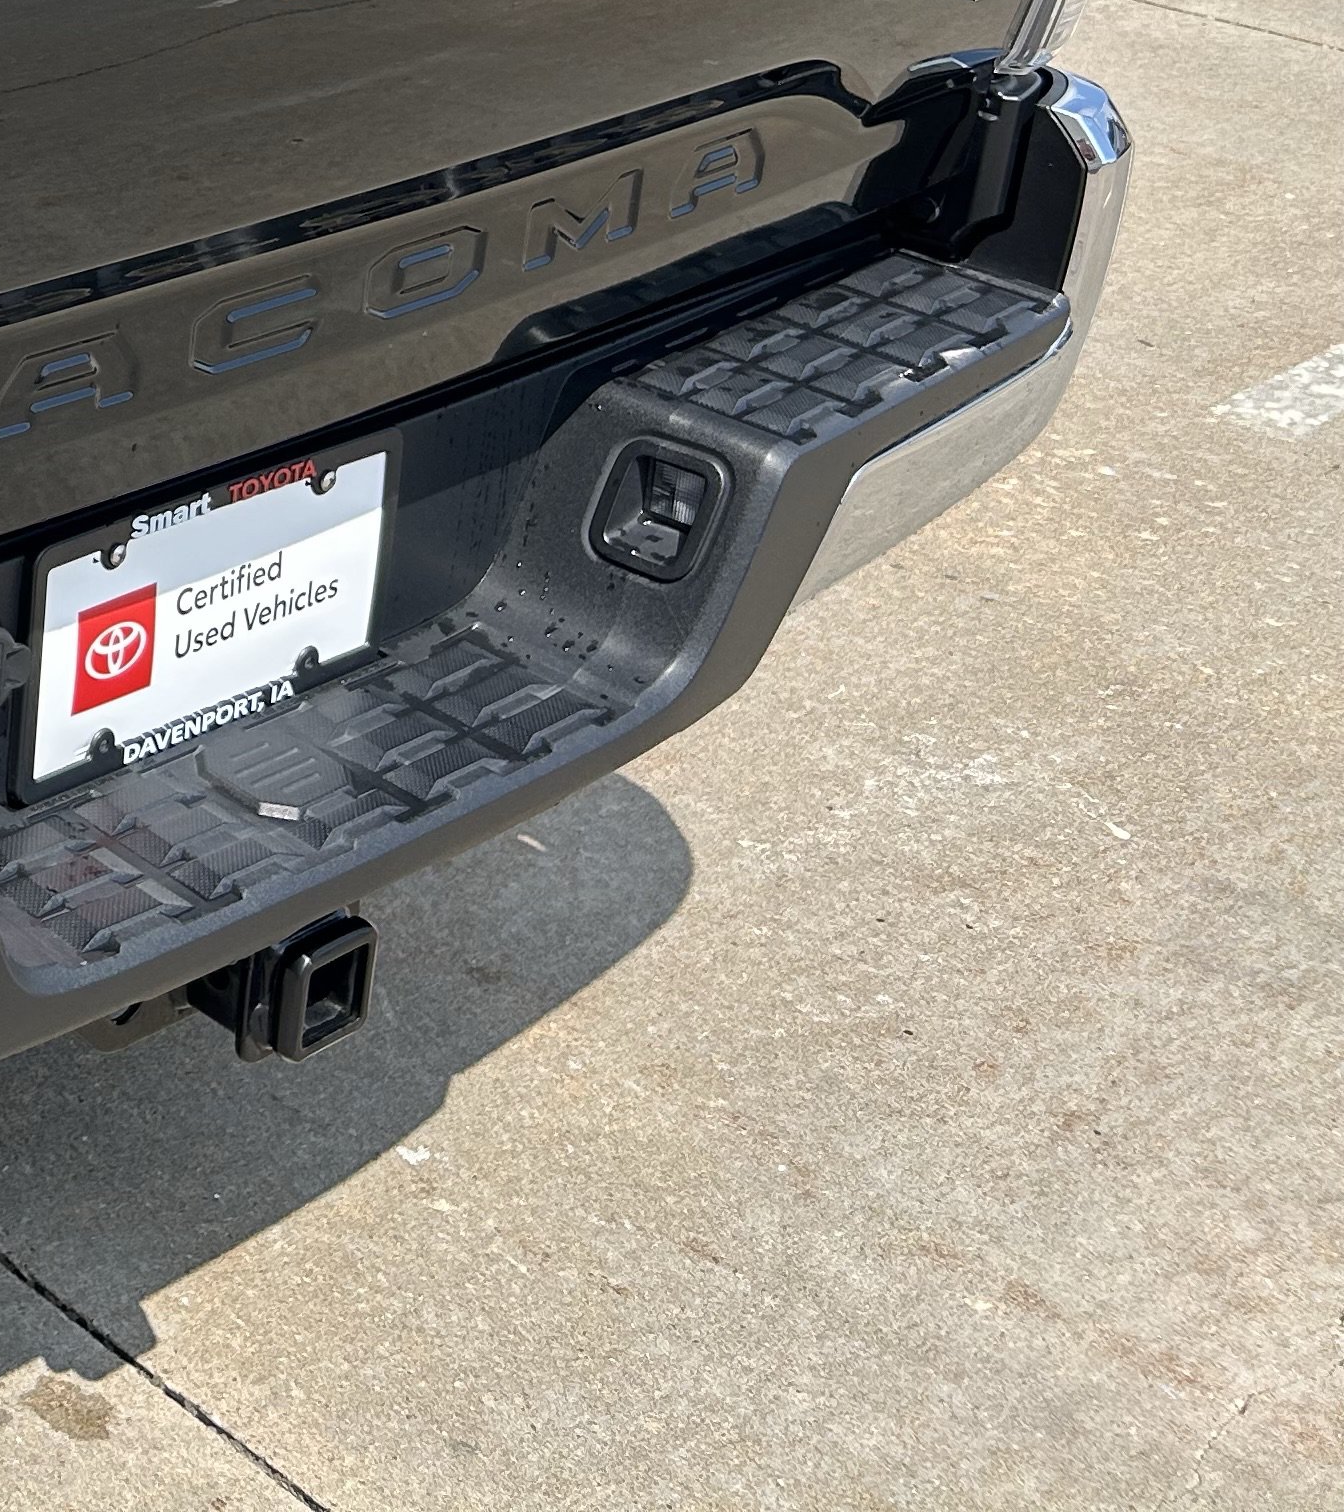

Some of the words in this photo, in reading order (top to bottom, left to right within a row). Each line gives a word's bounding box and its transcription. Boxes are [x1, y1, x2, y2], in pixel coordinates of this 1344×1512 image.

[131, 492, 212, 540] Smart
[229, 459, 318, 504] TOYOTA
[174, 611, 236, 659] Used
[243, 577, 340, 632] Vehicles
[176, 551, 284, 616] Certified
[123, 693, 267, 766] DAVENPORT,
[269, 680, 294, 704] IA
